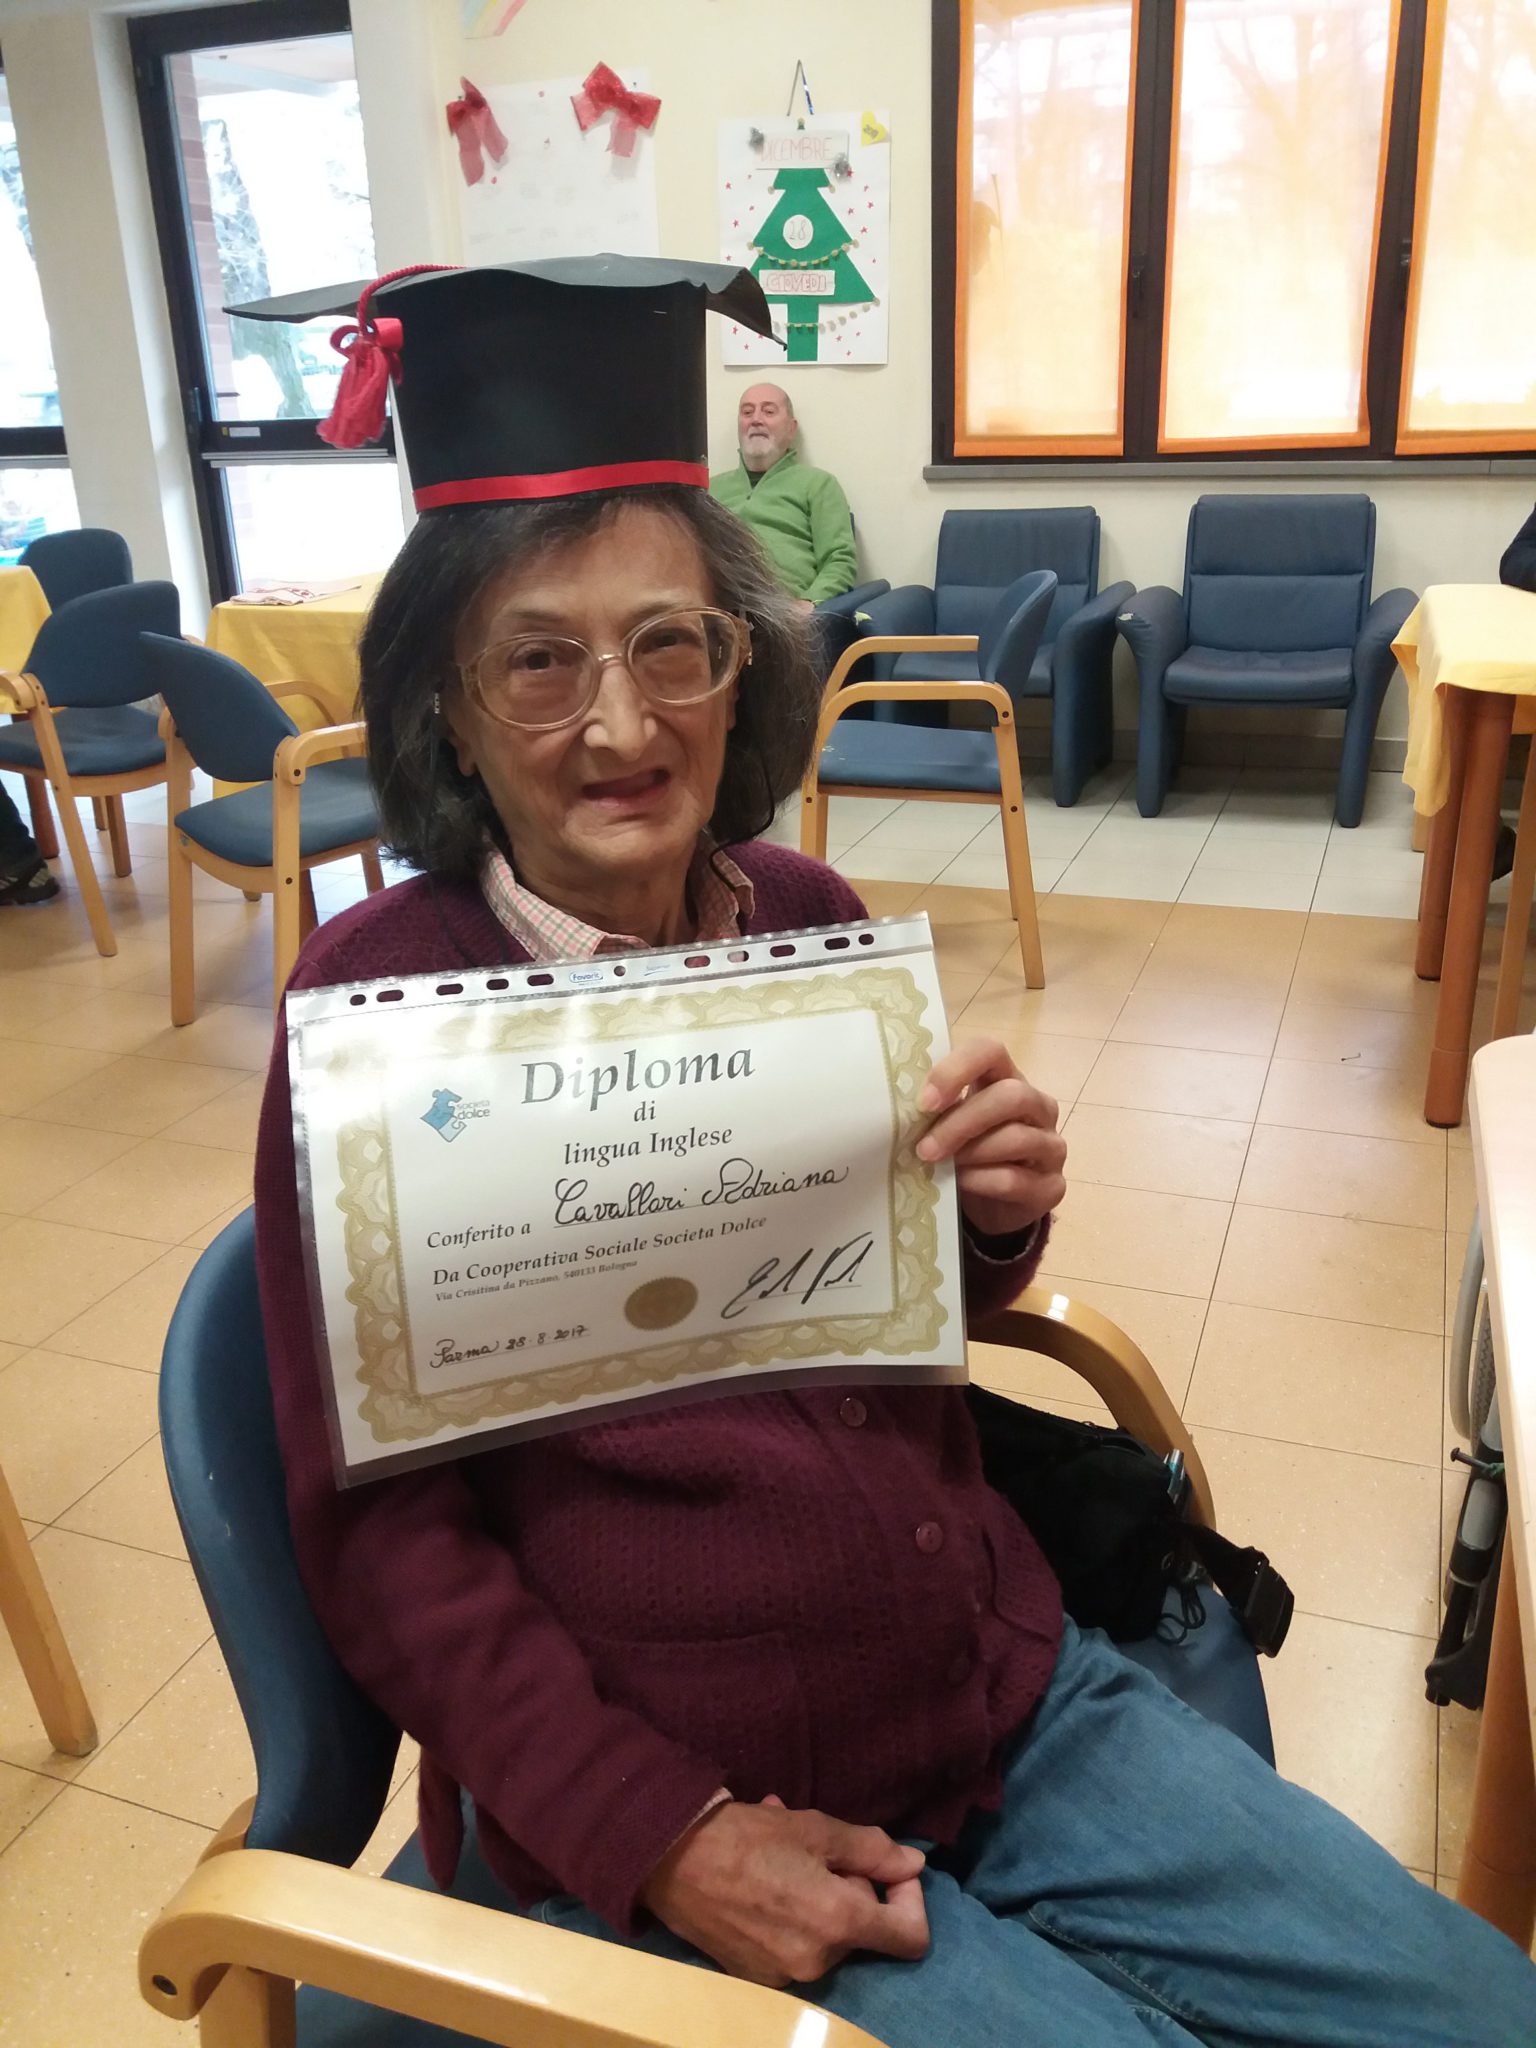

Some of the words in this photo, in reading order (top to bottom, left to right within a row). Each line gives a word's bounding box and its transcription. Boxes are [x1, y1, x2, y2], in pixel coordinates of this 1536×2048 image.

[521, 1049, 756, 1111] Diploma
[458, 1108, 490, 1120] dolce
[633, 1101, 657, 1122] di
[564, 1142, 641, 1167] lingua
[649, 1127, 733, 1157] Inglese
[554, 1178, 688, 1225] Cavallari
[427, 1224, 515, 1249] Conferito
[521, 1223, 531, 1235] a
[432, 1269, 459, 1285] Da
[466, 1251, 578, 1278] Cooperativa
[584, 1237, 648, 1260] Sociale
[652, 1227, 714, 1248] Societa
[720, 1216, 767, 1236] Dolce
[435, 1292, 453, 1301] Via
[503, 1281, 516, 1290] da
[598, 1260, 638, 1274] Bologna
[429, 1338, 500, 1369] Parma
